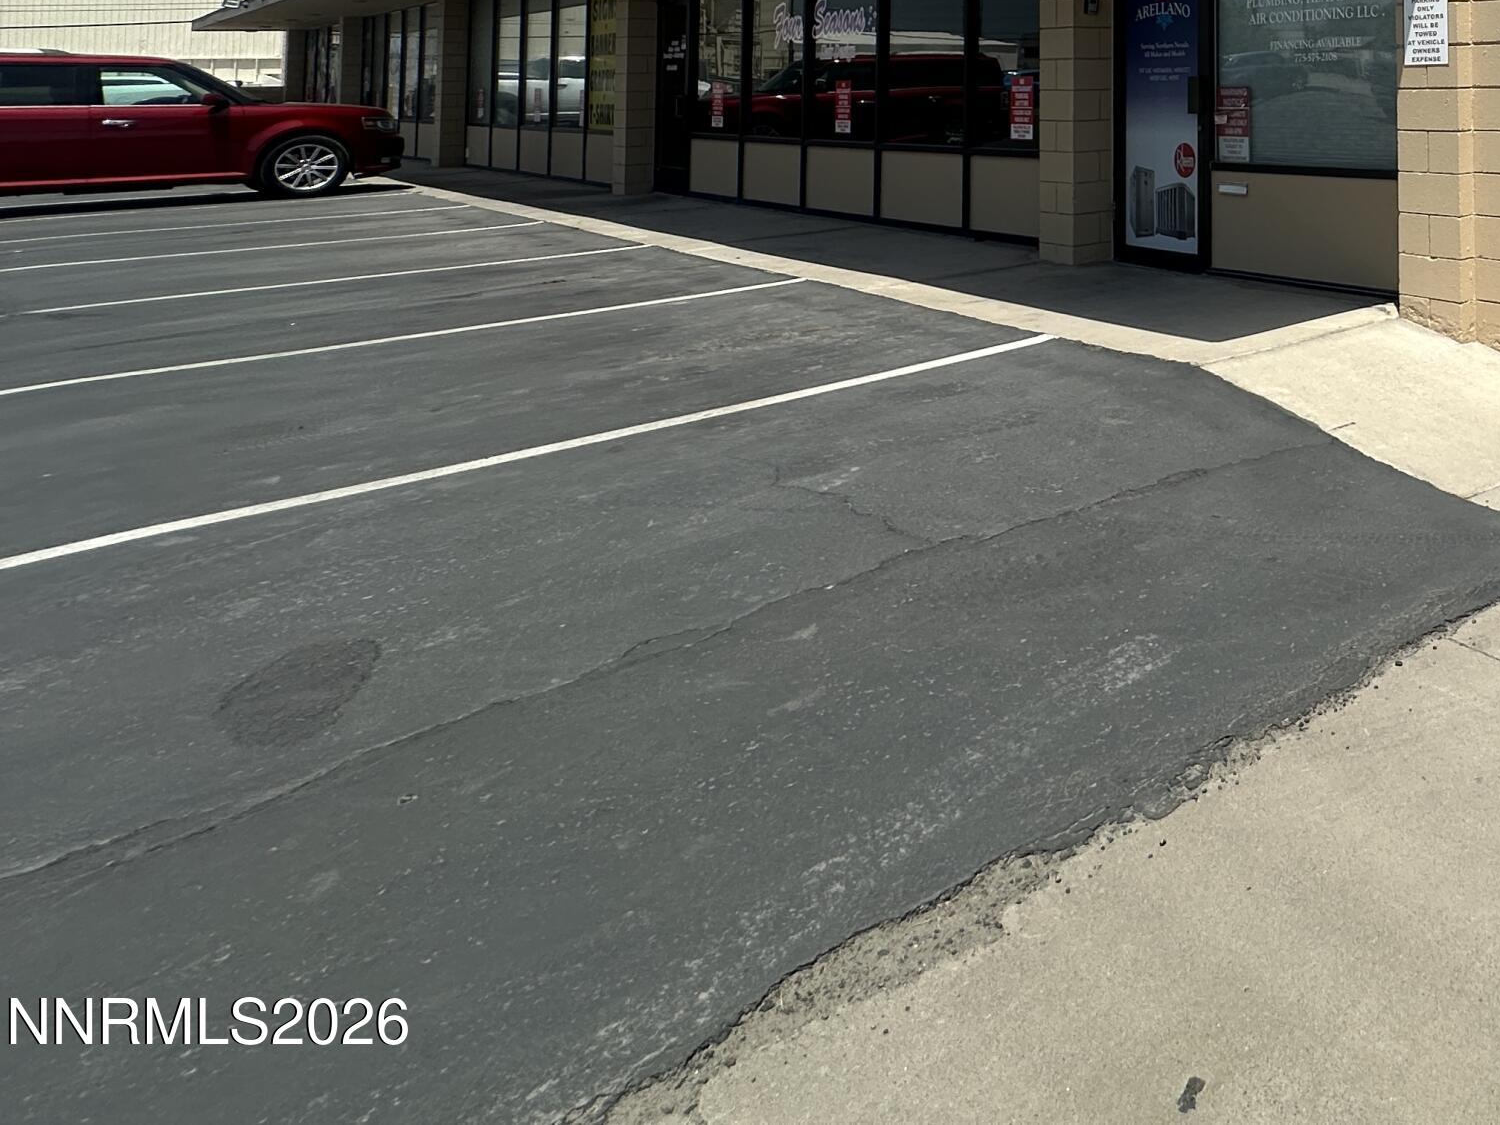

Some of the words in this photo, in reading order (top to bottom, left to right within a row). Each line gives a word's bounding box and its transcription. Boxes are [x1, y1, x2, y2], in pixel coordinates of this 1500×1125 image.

[1135, 2, 1191, 22] ARELLANO
[1248, 12, 1267, 25] AIR
[1269, 6, 1353, 24] CONDITIONING
[1408, 13, 1444, 21] VIOLATORS
[1270, 38, 1314, 51] FINANCING
[1317, 36, 1362, 49] AVAILABLE
[1411, 55, 1441, 63] EXPENSE
